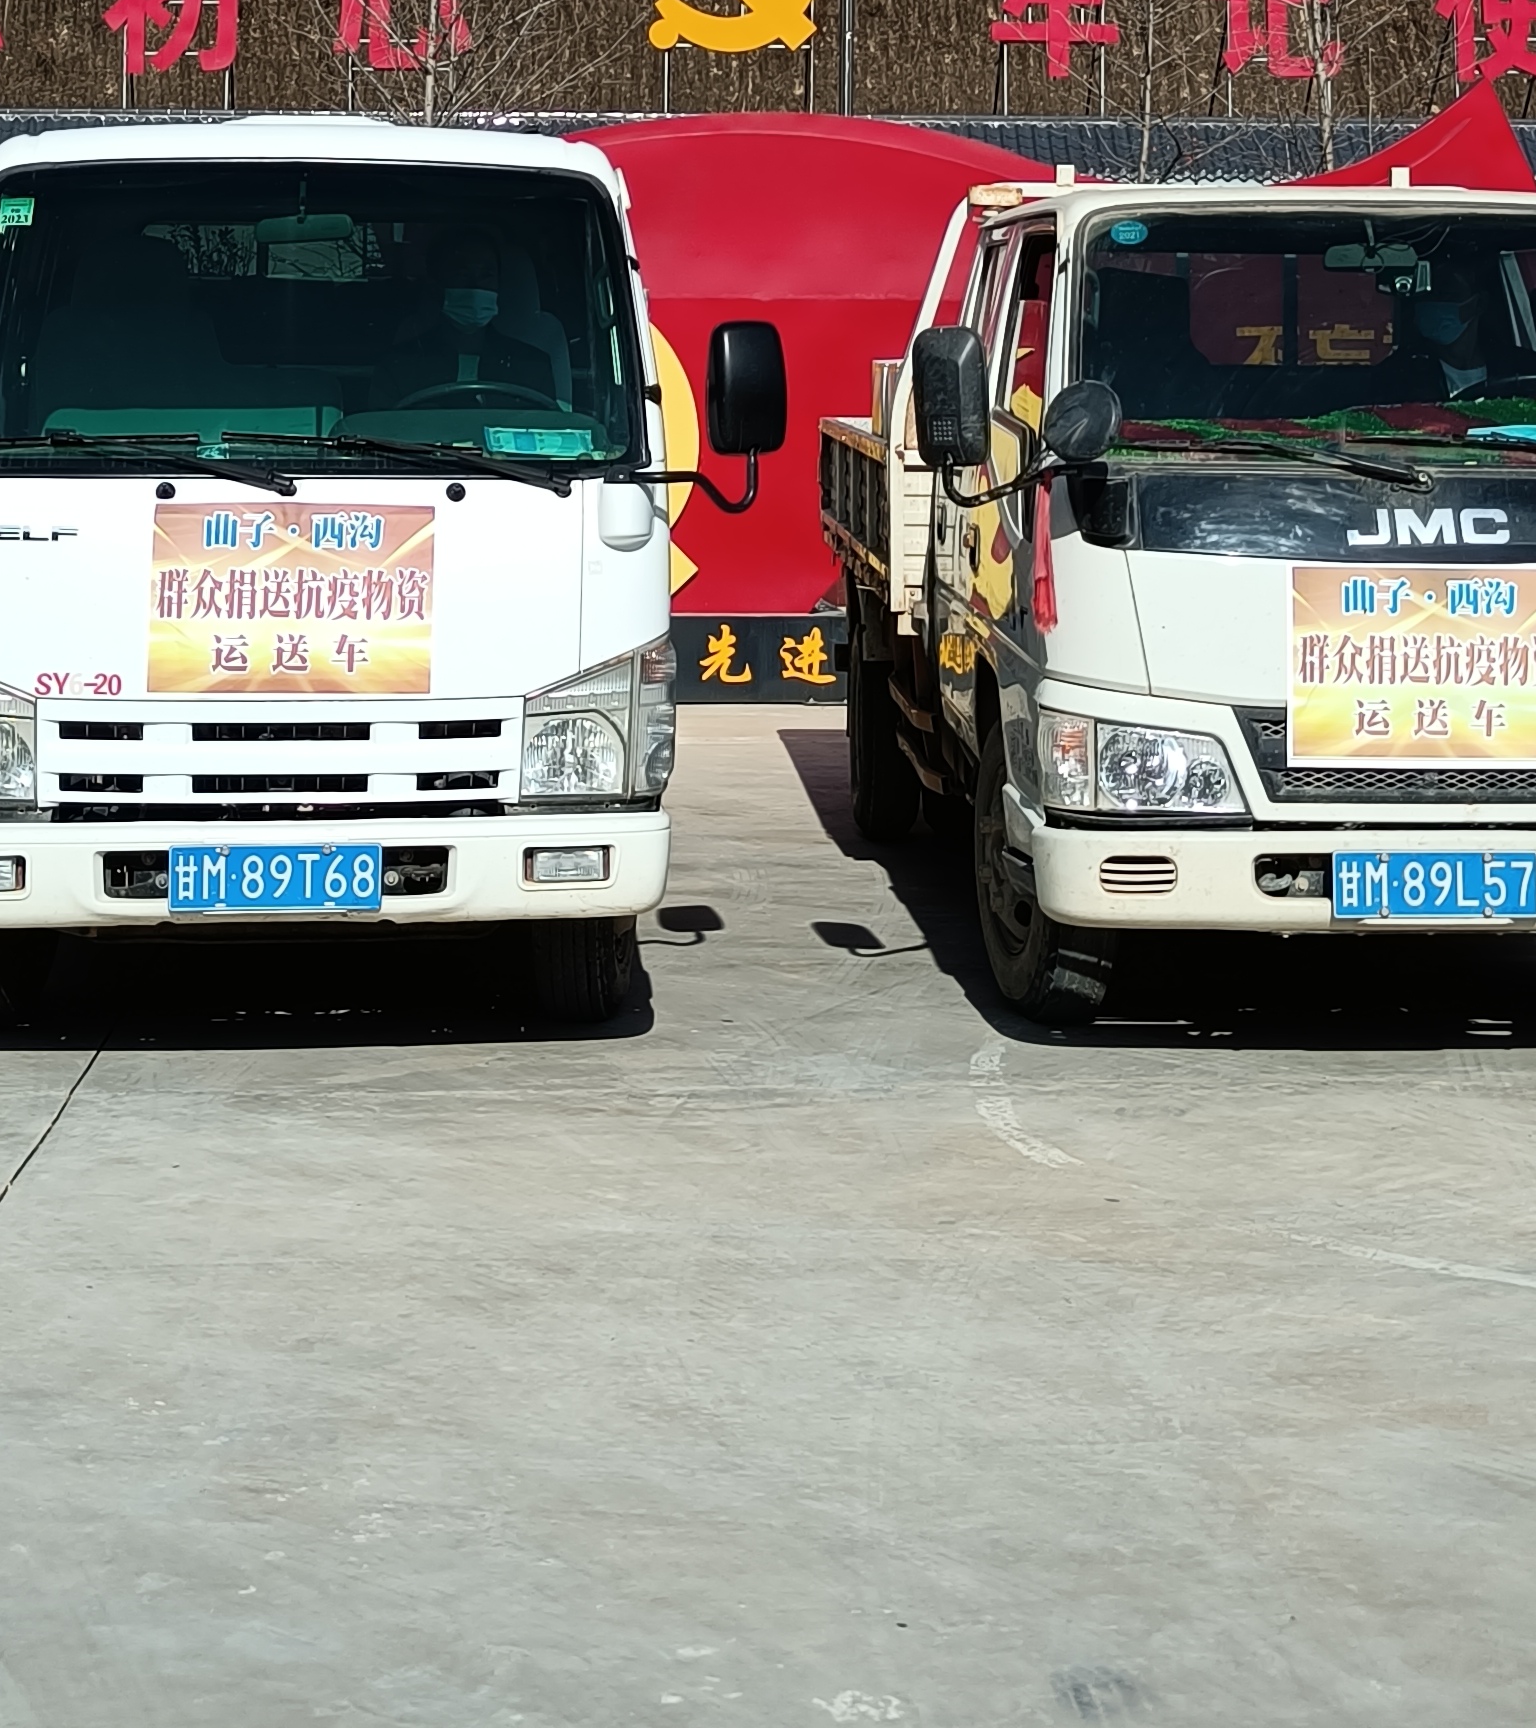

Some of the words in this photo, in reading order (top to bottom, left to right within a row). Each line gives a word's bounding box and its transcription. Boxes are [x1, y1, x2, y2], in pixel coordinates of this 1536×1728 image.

[204, 512, 385, 550] 曲子·西沟
[1347, 508, 1510, 546] JMC
[156, 569, 428, 621] 群众捐送抗疫物资
[1343, 578, 1516, 614] 曲子·西沟
[212, 633, 369, 673] 运送车
[699, 624, 836, 684] 先进
[1355, 699, 1506, 737] 运送车
